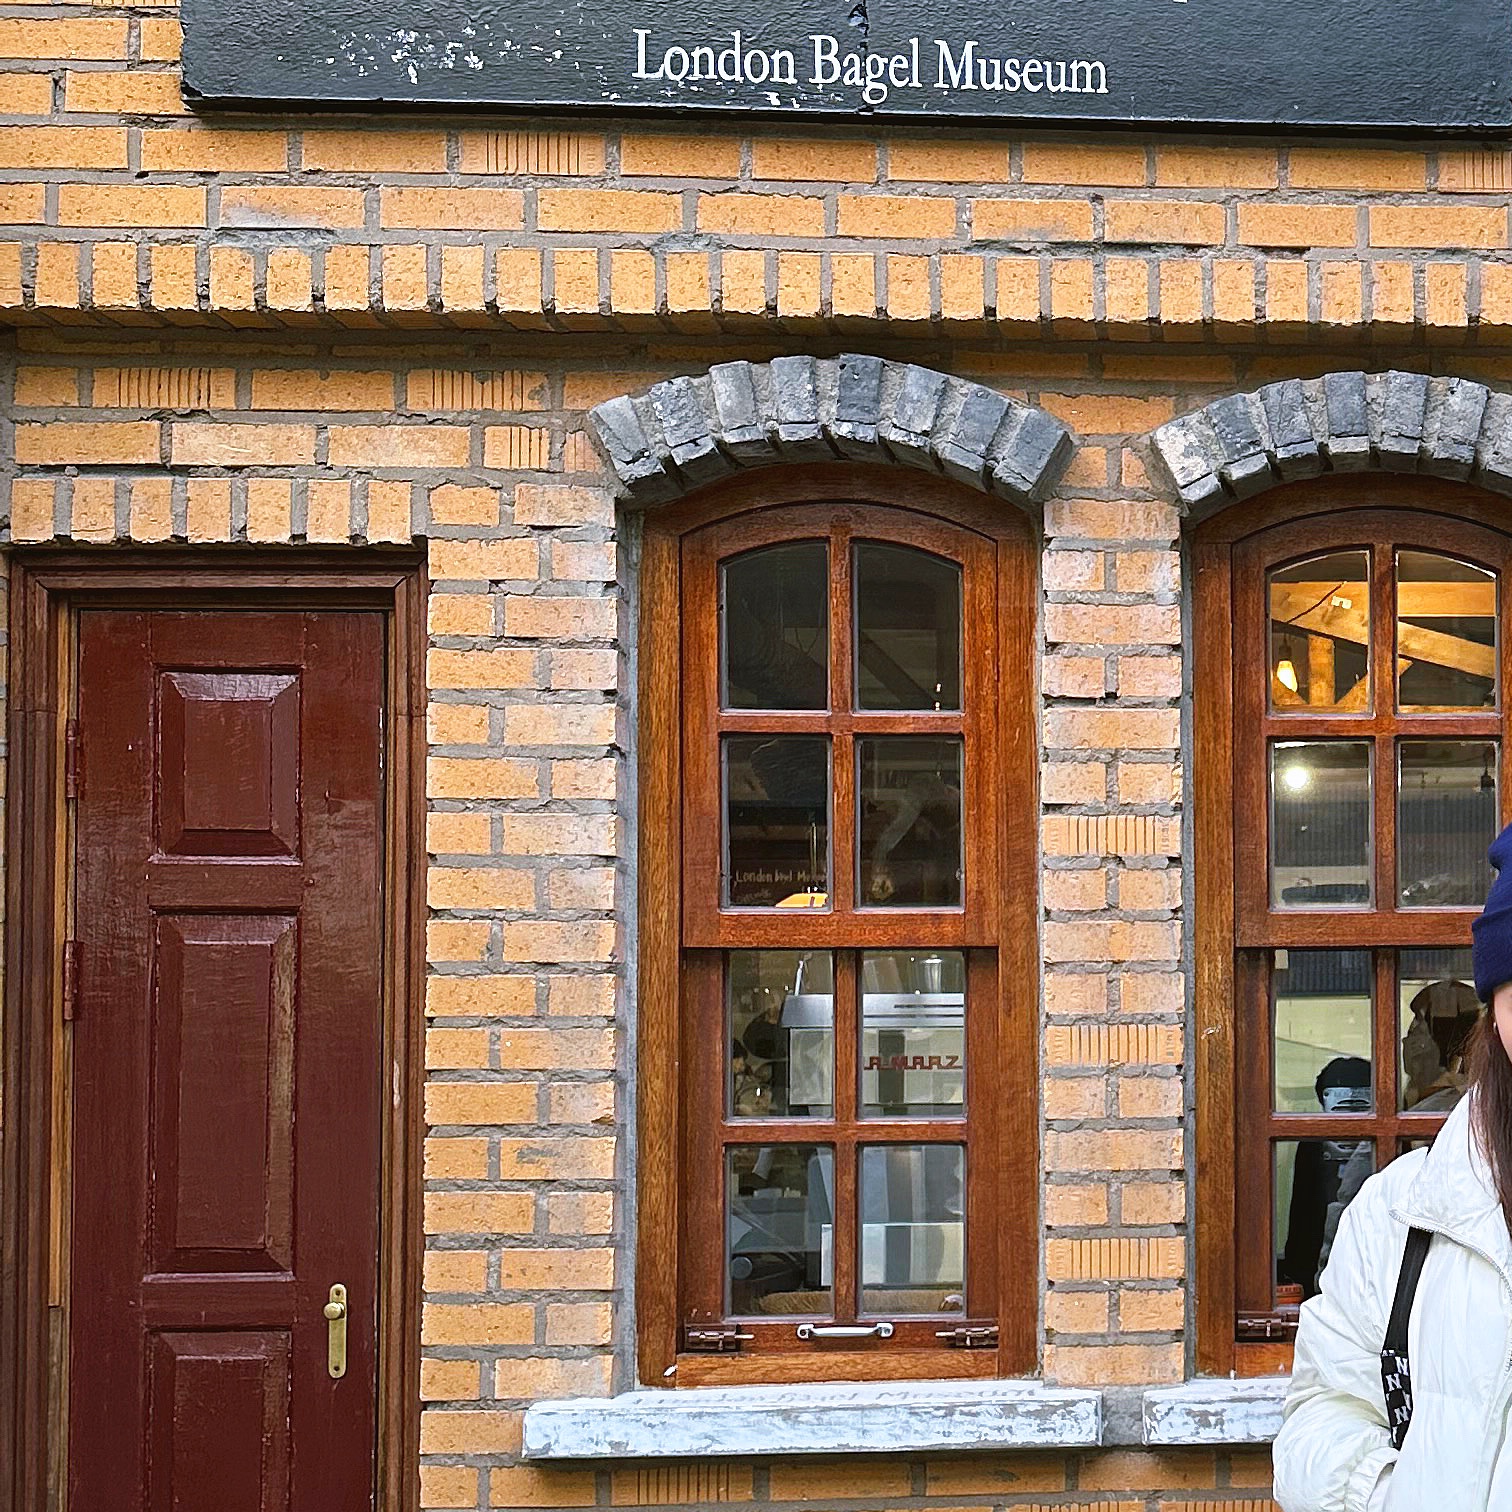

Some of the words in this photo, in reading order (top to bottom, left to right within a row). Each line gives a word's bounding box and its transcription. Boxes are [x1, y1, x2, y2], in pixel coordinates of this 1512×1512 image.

[632, 28, 797, 85] London
[808, 34, 923, 104] Bagel
[933, 39, 1109, 95] Museum
